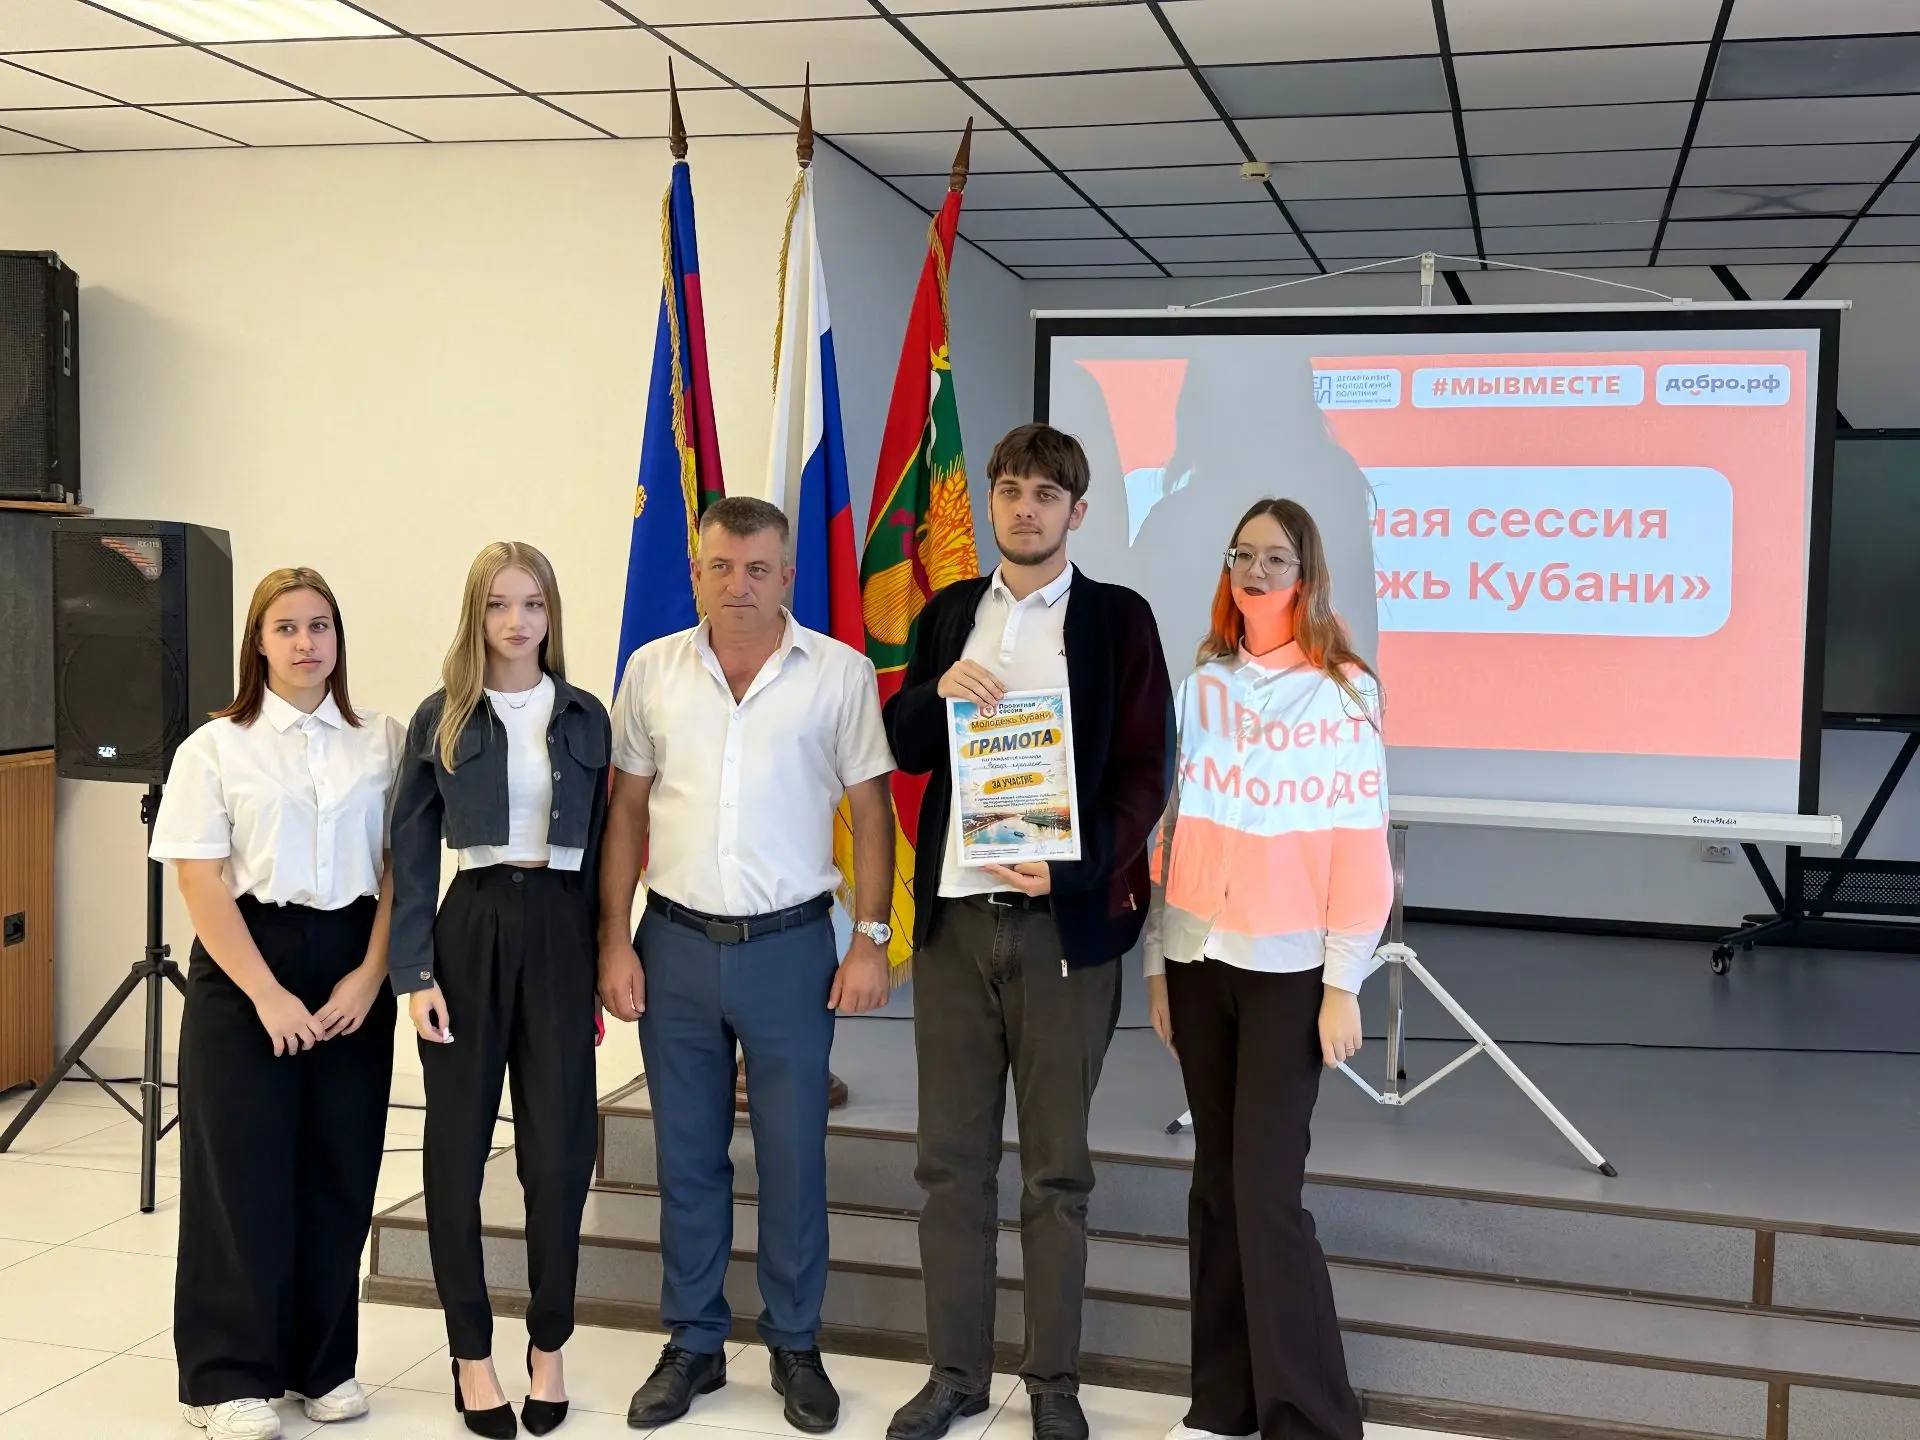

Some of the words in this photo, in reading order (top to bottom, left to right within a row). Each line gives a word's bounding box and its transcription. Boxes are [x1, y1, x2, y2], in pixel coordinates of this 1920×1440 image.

[1432, 375, 1621, 396] #МЫВМЕСТЕ
[1665, 374, 1781, 393] добро.рф
[1467, 508, 1667, 539] сессия
[1375, 570, 1451, 600] жь
[1469, 561, 1711, 611] Кубани»
[969, 729, 1054, 756] ГРАМОТА
[991, 779, 1002, 789] ЗА
[1002, 774, 1034, 788] УЧАСТИЕ
